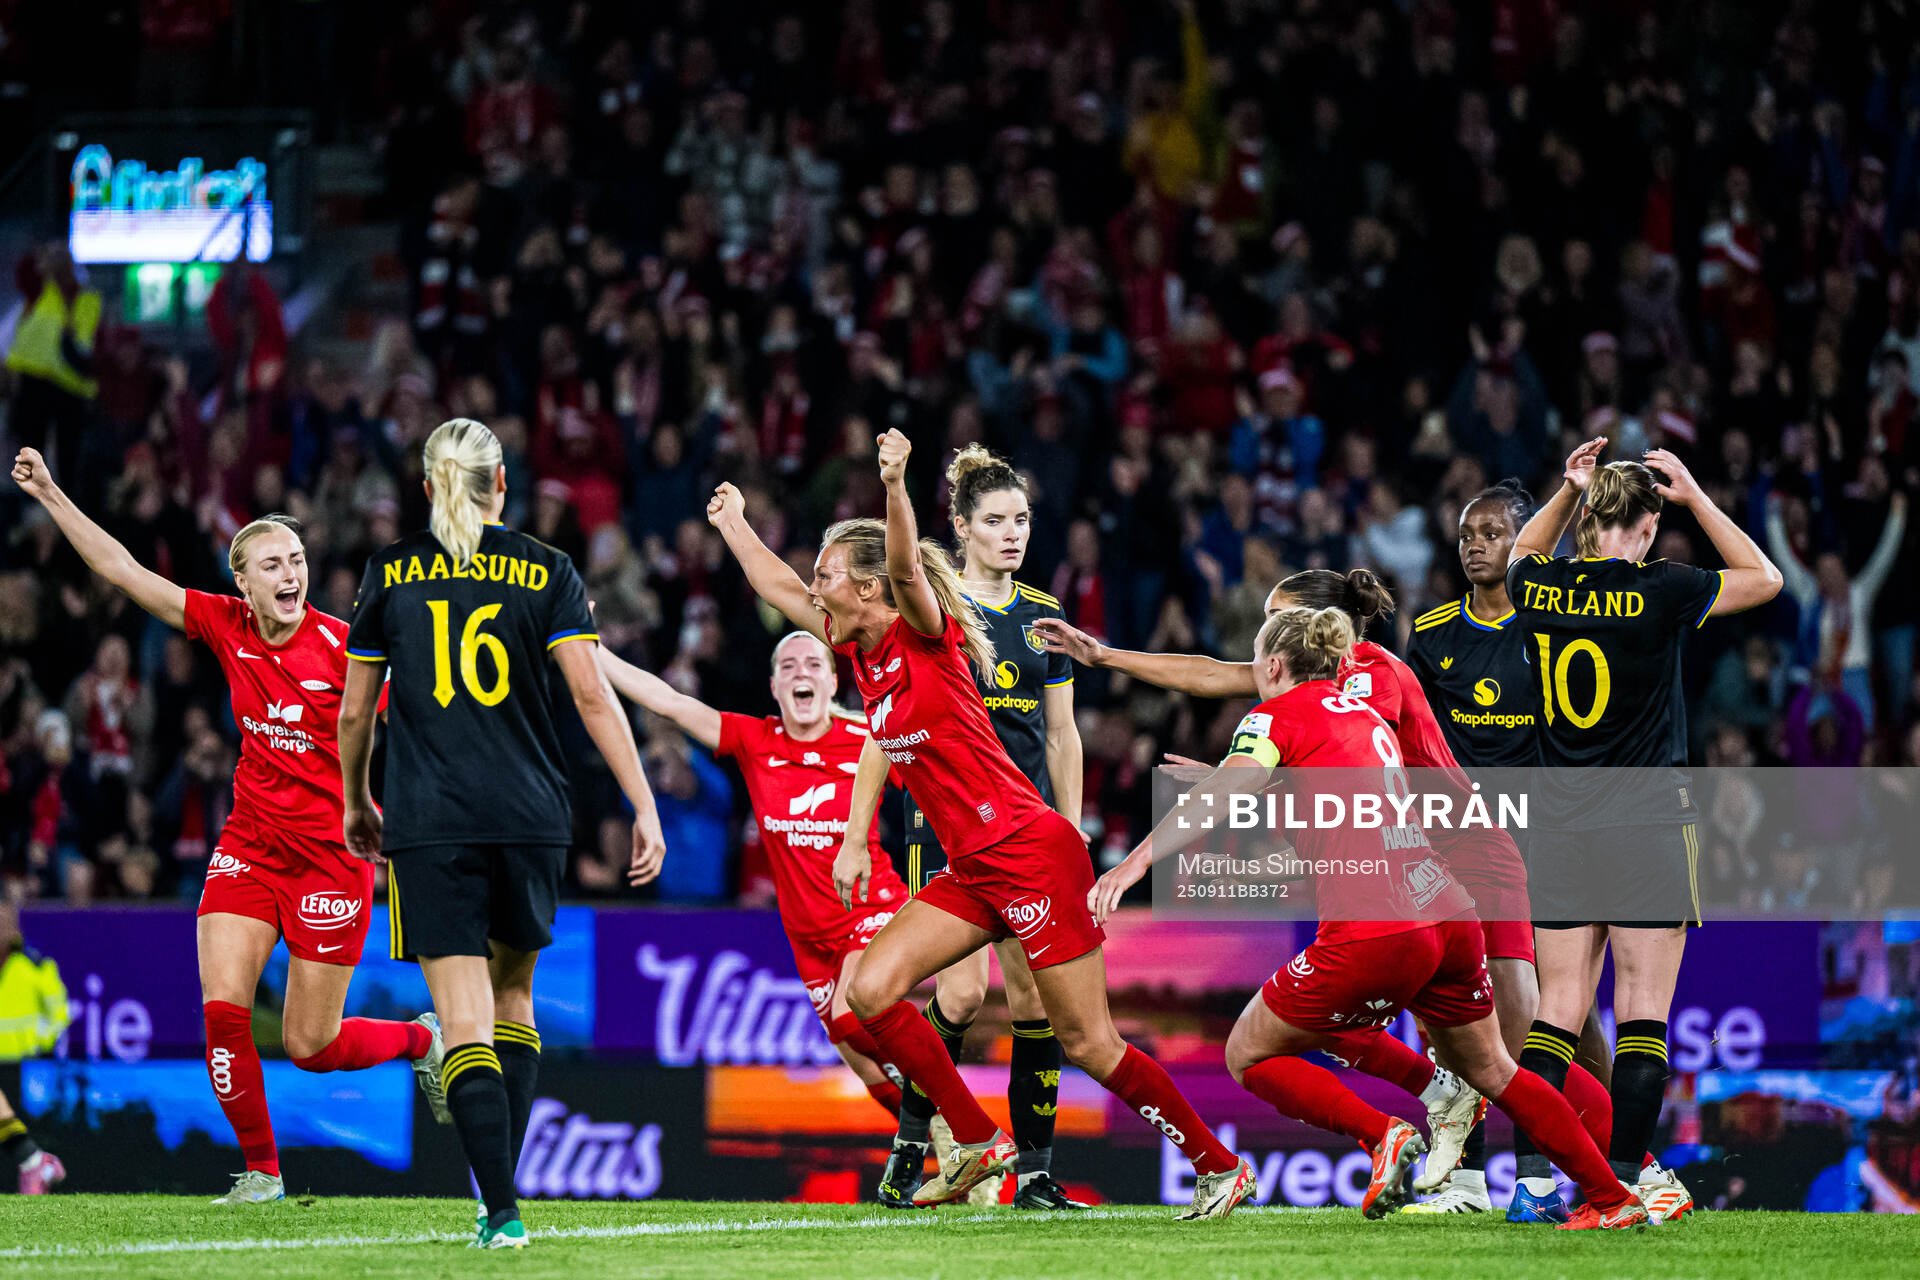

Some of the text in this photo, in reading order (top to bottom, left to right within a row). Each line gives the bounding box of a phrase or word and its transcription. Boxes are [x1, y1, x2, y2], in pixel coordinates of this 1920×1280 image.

[384, 553, 549, 591] NAALSUND
[1523, 580, 1645, 617] TERLAND
[426, 600, 510, 708] 16
[1533, 632, 1611, 729] 10
[983, 694, 1039, 713] apdrago
[1451, 709, 1535, 728] Snapdragon
[269, 736, 315, 753] Norge
[876, 728, 930, 750] rebanken
[764, 815, 848, 833] Sparebanke
[787, 832, 834, 850] Norge
[301, 895, 358, 917] LERØY
